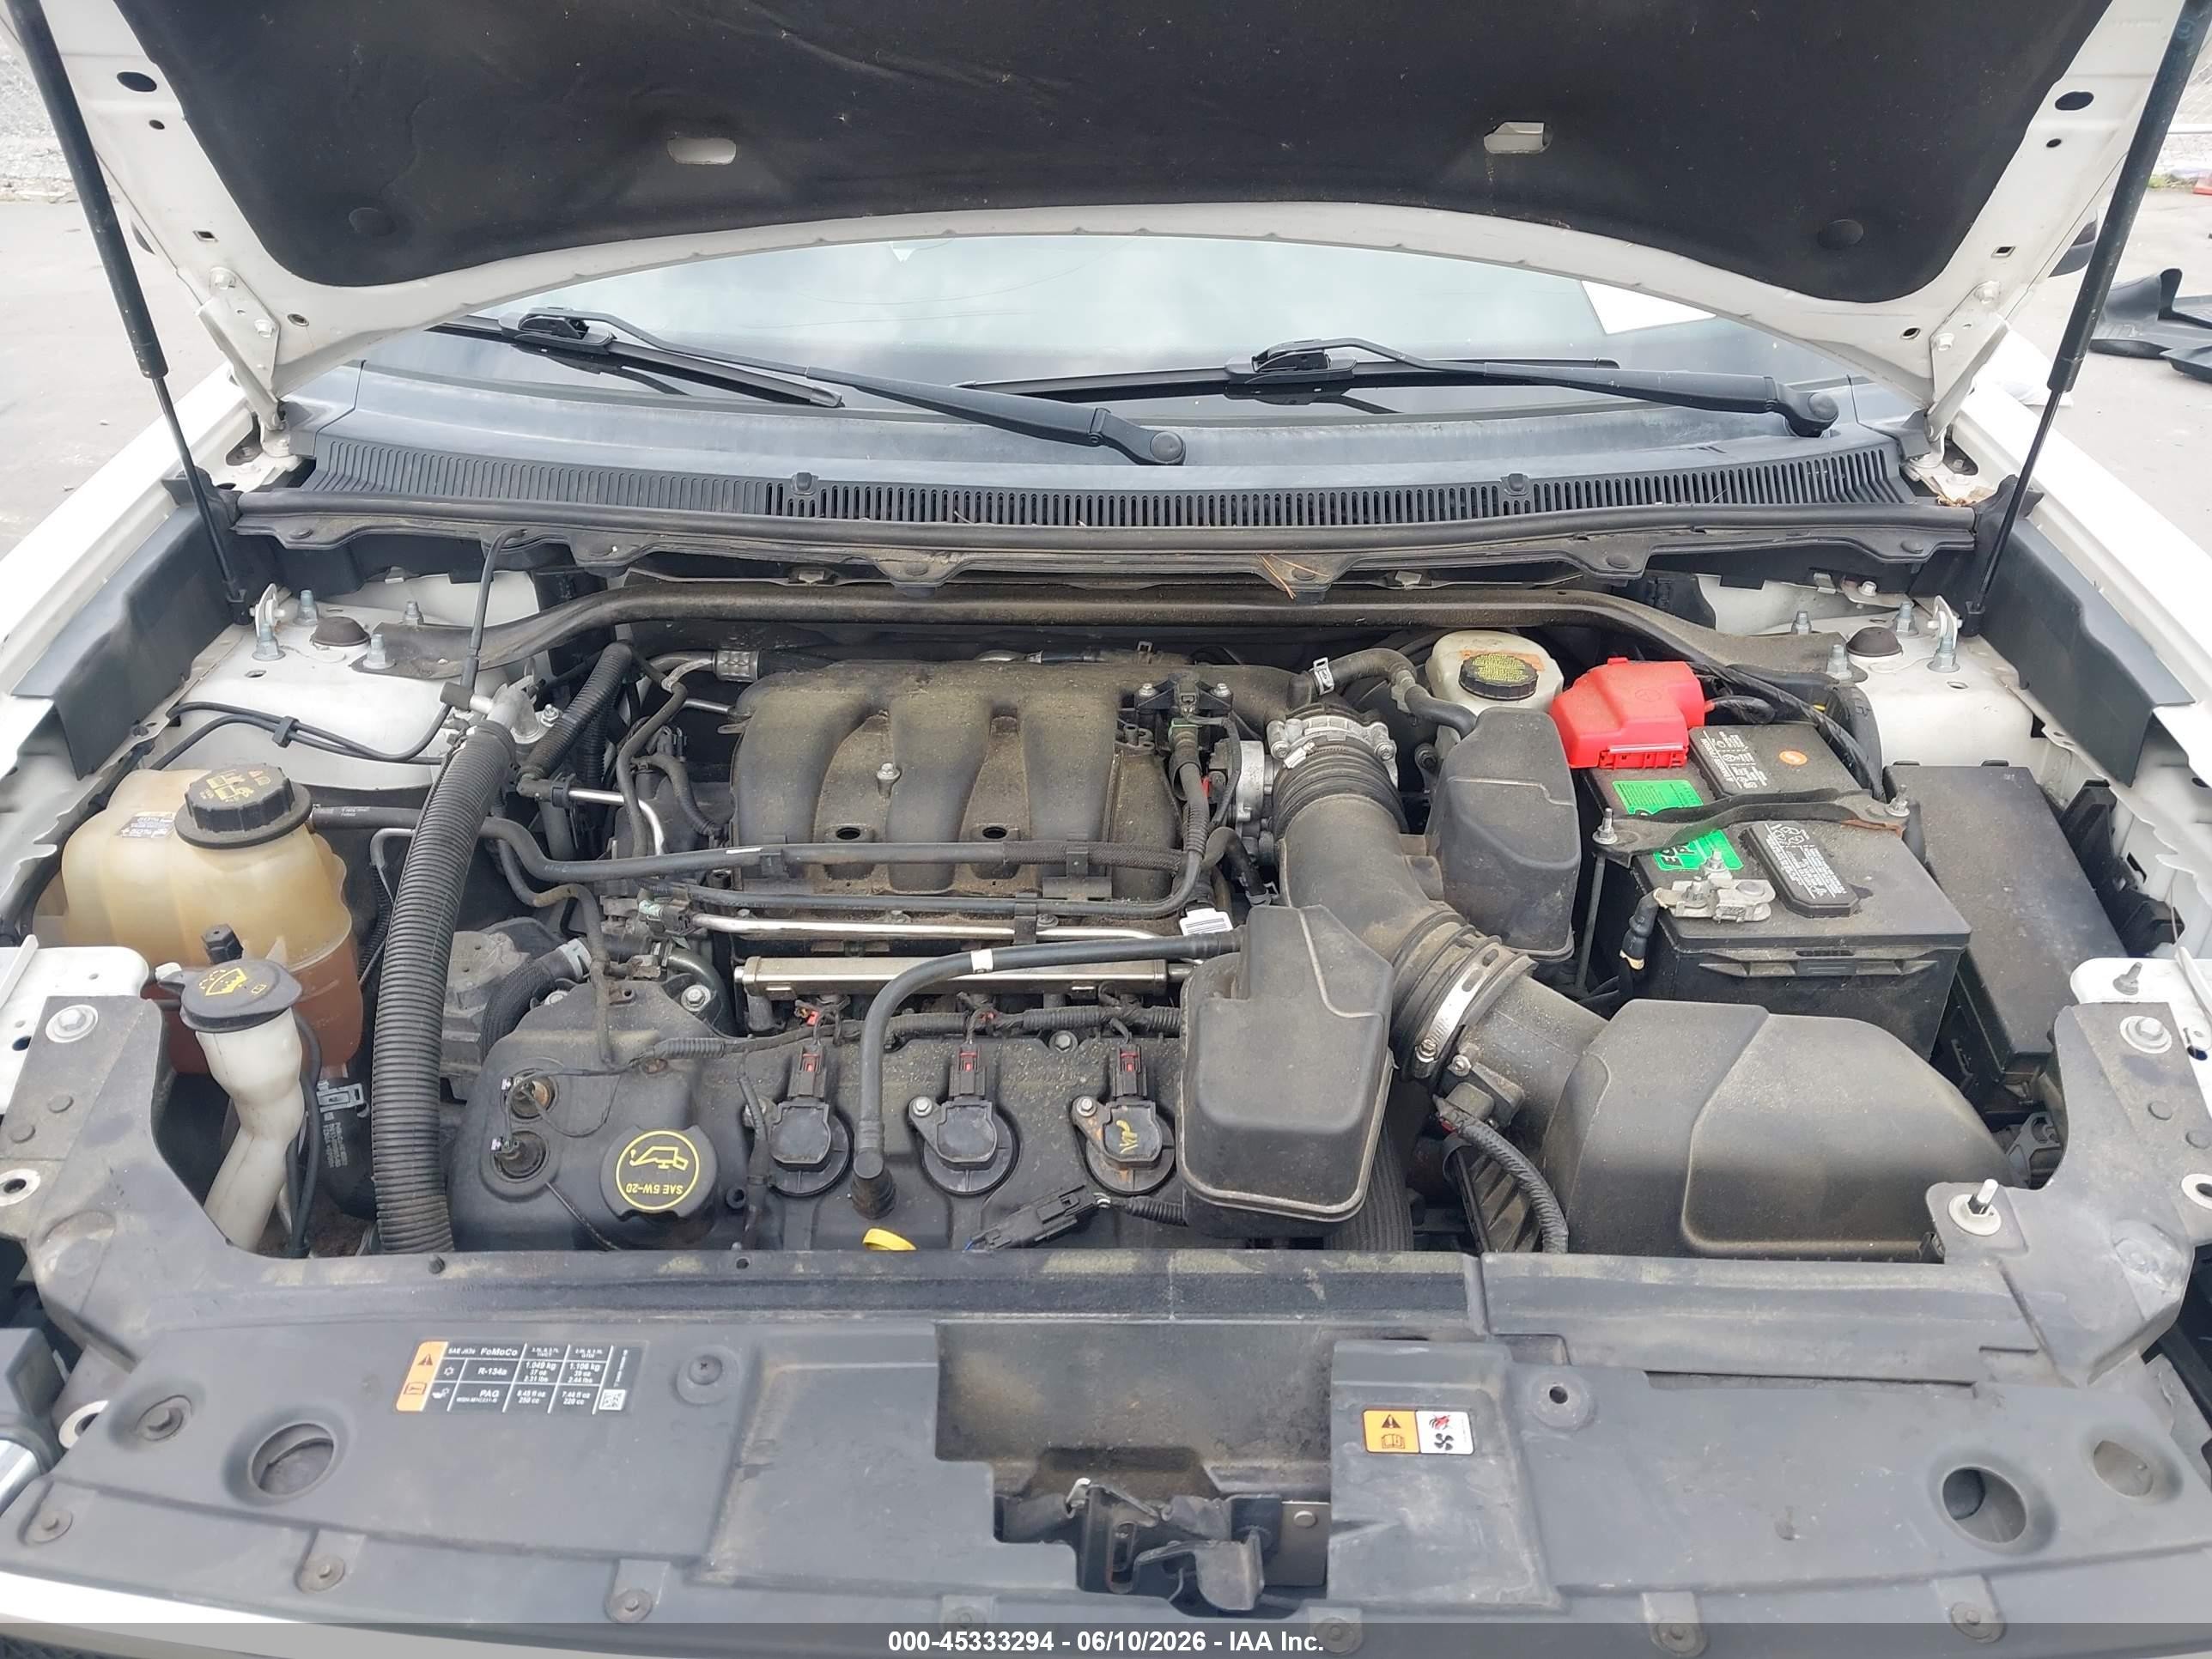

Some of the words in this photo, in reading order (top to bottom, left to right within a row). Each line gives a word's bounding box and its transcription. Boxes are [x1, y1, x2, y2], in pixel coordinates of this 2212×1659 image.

[625, 1182, 660, 1194] 5W-20
[662, 1185, 684, 1194] SAE
[480, 1347, 519, 1356] FoMoCo
[546, 1362, 557, 1371] kg
[590, 1363, 601, 1372] kg
[477, 1367, 507, 1376] R-134a
[479, 1389, 500, 1398] PAG
